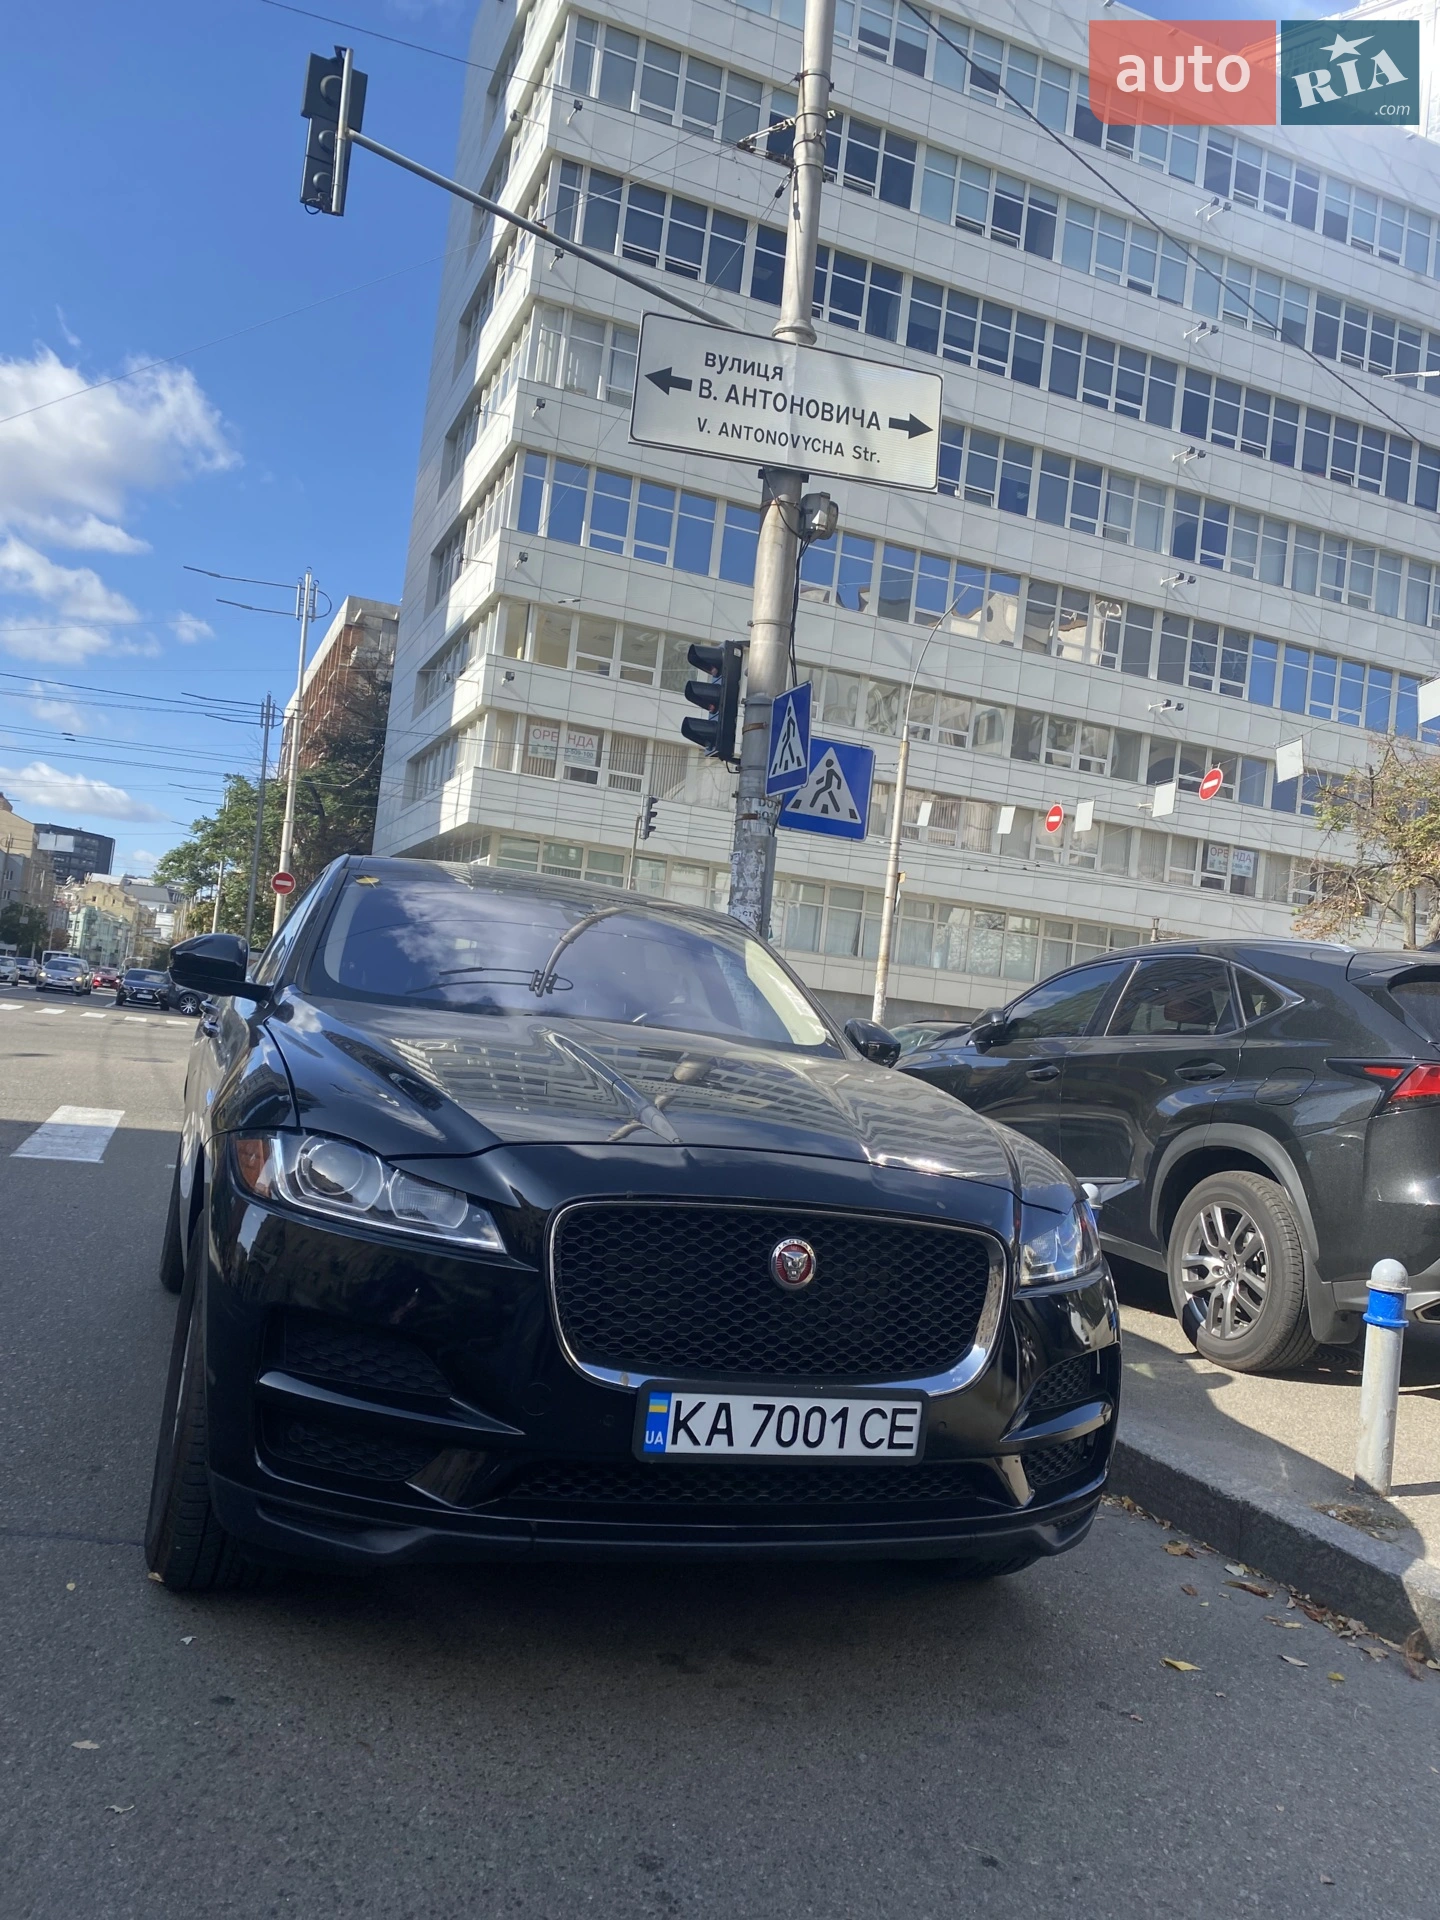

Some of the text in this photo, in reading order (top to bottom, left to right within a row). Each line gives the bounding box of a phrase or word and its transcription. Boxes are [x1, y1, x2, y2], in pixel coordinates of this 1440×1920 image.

[704, 351, 783, 381] вулиця
[698, 378, 881, 431] В. АНТОНОВИЧА
[697, 417, 881, 463] V. ANTONOVYCHA Str.
[645, 1430, 664, 1445] UA
[670, 1400, 918, 1450] KA 7001 CE
